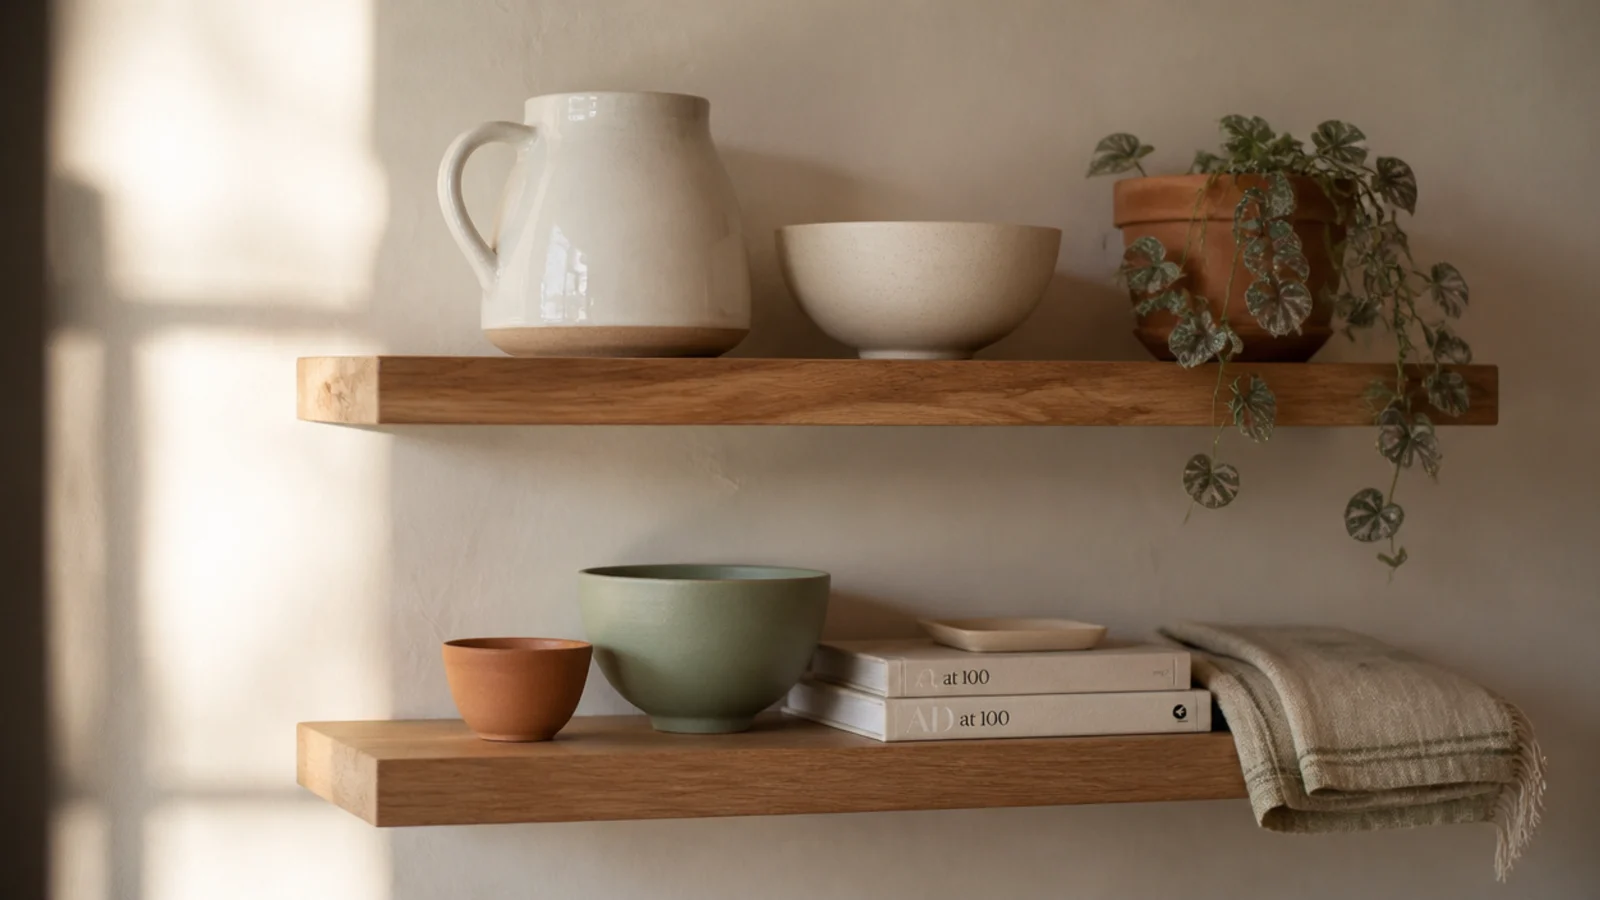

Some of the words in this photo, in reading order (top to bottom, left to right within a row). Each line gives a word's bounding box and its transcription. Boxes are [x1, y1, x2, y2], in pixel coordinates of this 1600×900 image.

[943, 671, 958, 686] at
[962, 669, 990, 685] 100
[959, 712, 976, 727] at
[980, 709, 1010, 727] 100
